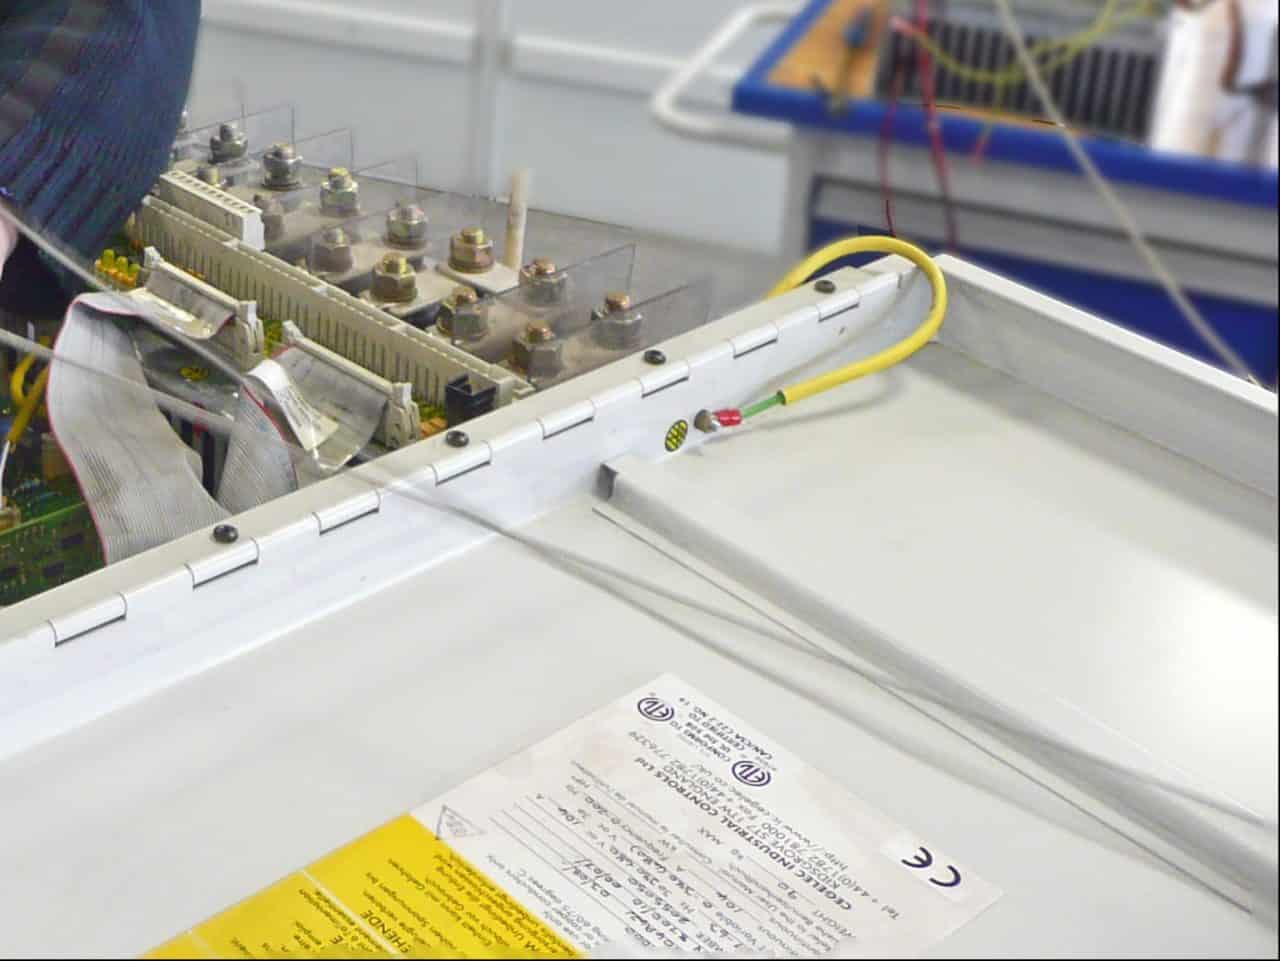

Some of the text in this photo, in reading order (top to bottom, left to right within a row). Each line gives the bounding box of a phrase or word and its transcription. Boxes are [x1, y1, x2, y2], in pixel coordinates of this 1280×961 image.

[680, 728, 732, 763] CONFORMS
[700, 720, 746, 751] CERTIFIED
[660, 764, 720, 805] ENGLAND
[734, 804, 758, 820] Fax
[632, 756, 853, 911] CEGELEC INDUSTRIAL CONTROLS Ltd
[696, 826, 724, 846] MAX
[769, 840, 840, 889] KIDSGROVE
[502, 868, 553, 907] conductors
[753, 894, 778, 912] User
[711, 910, 760, 945] Variable
[776, 910, 796, 925] the
[879, 904, 901, 920] Tel
